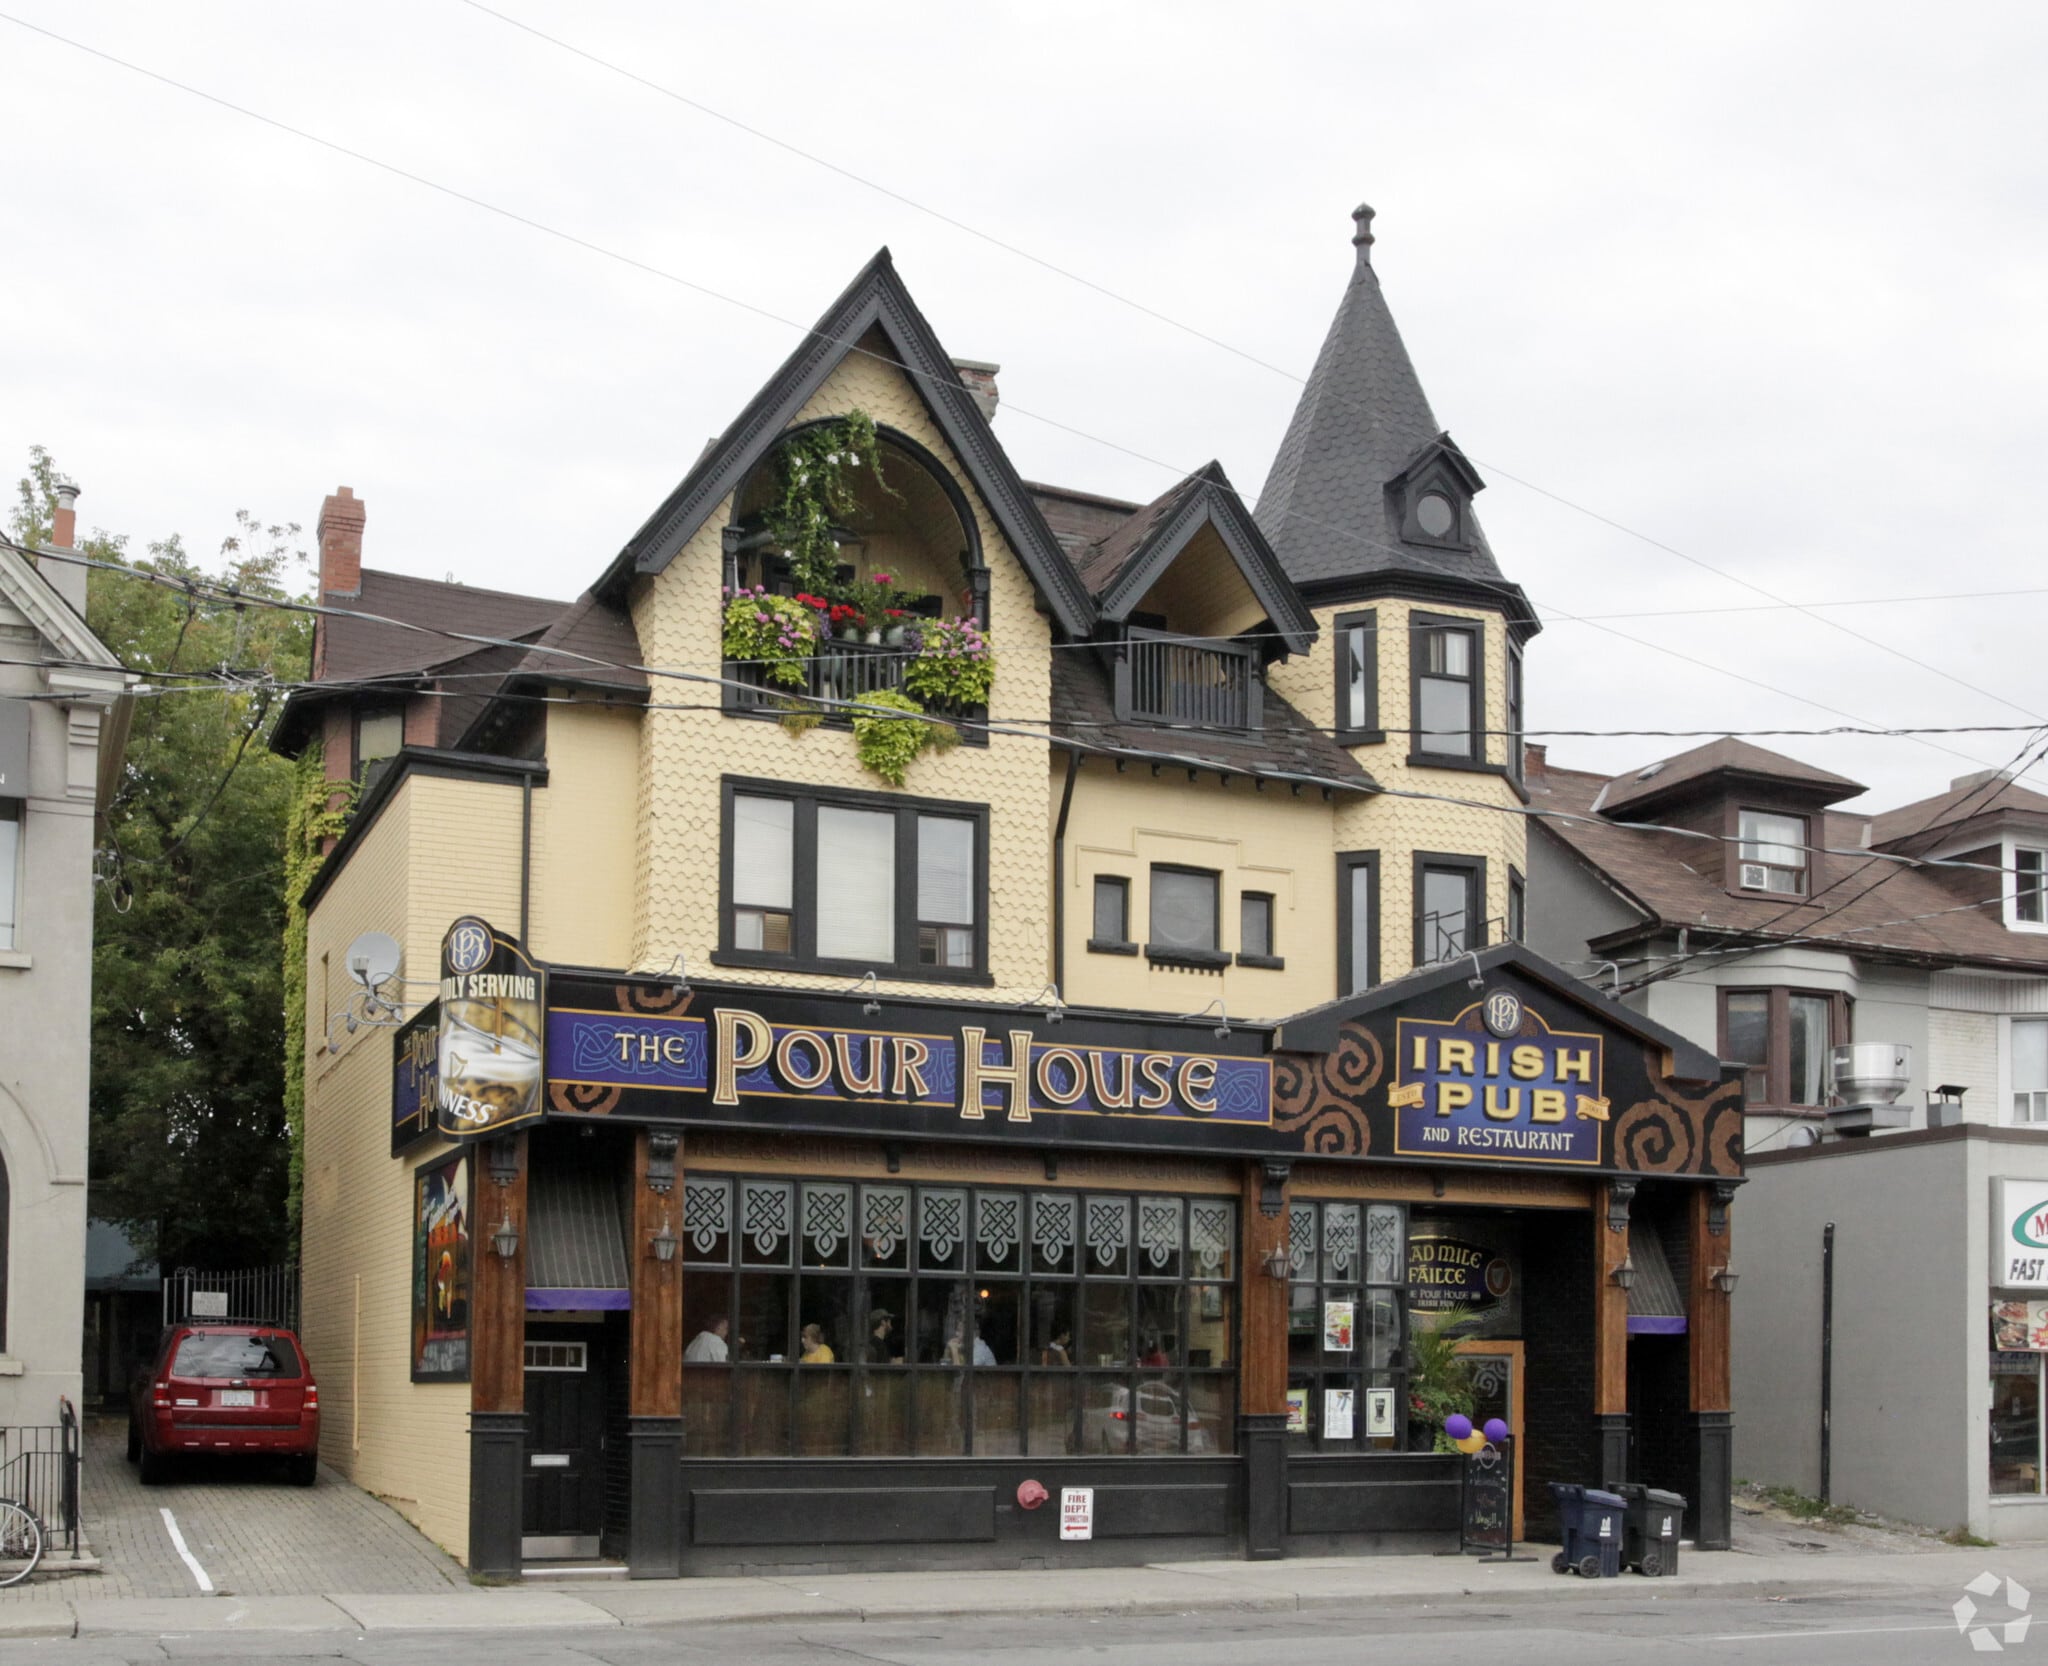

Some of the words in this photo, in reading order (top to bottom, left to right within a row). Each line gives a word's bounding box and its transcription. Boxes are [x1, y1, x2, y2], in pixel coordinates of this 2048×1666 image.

[469, 974, 536, 1000] SERVING
[614, 1032, 686, 1064] THE
[712, 1006, 930, 1106] POUR
[960, 1026, 1218, 1122] HOUSE
[1412, 1036, 1592, 1083] IRISH
[1436, 1081, 1568, 1123] PUB
[1422, 1126, 1451, 1143] AND
[1457, 1126, 1574, 1151] RESTAURANT
[1438, 1244, 1482, 1269] MILE
[2010, 1258, 2045, 1280] FAST
[1068, 1494, 1087, 1504] FIRE
